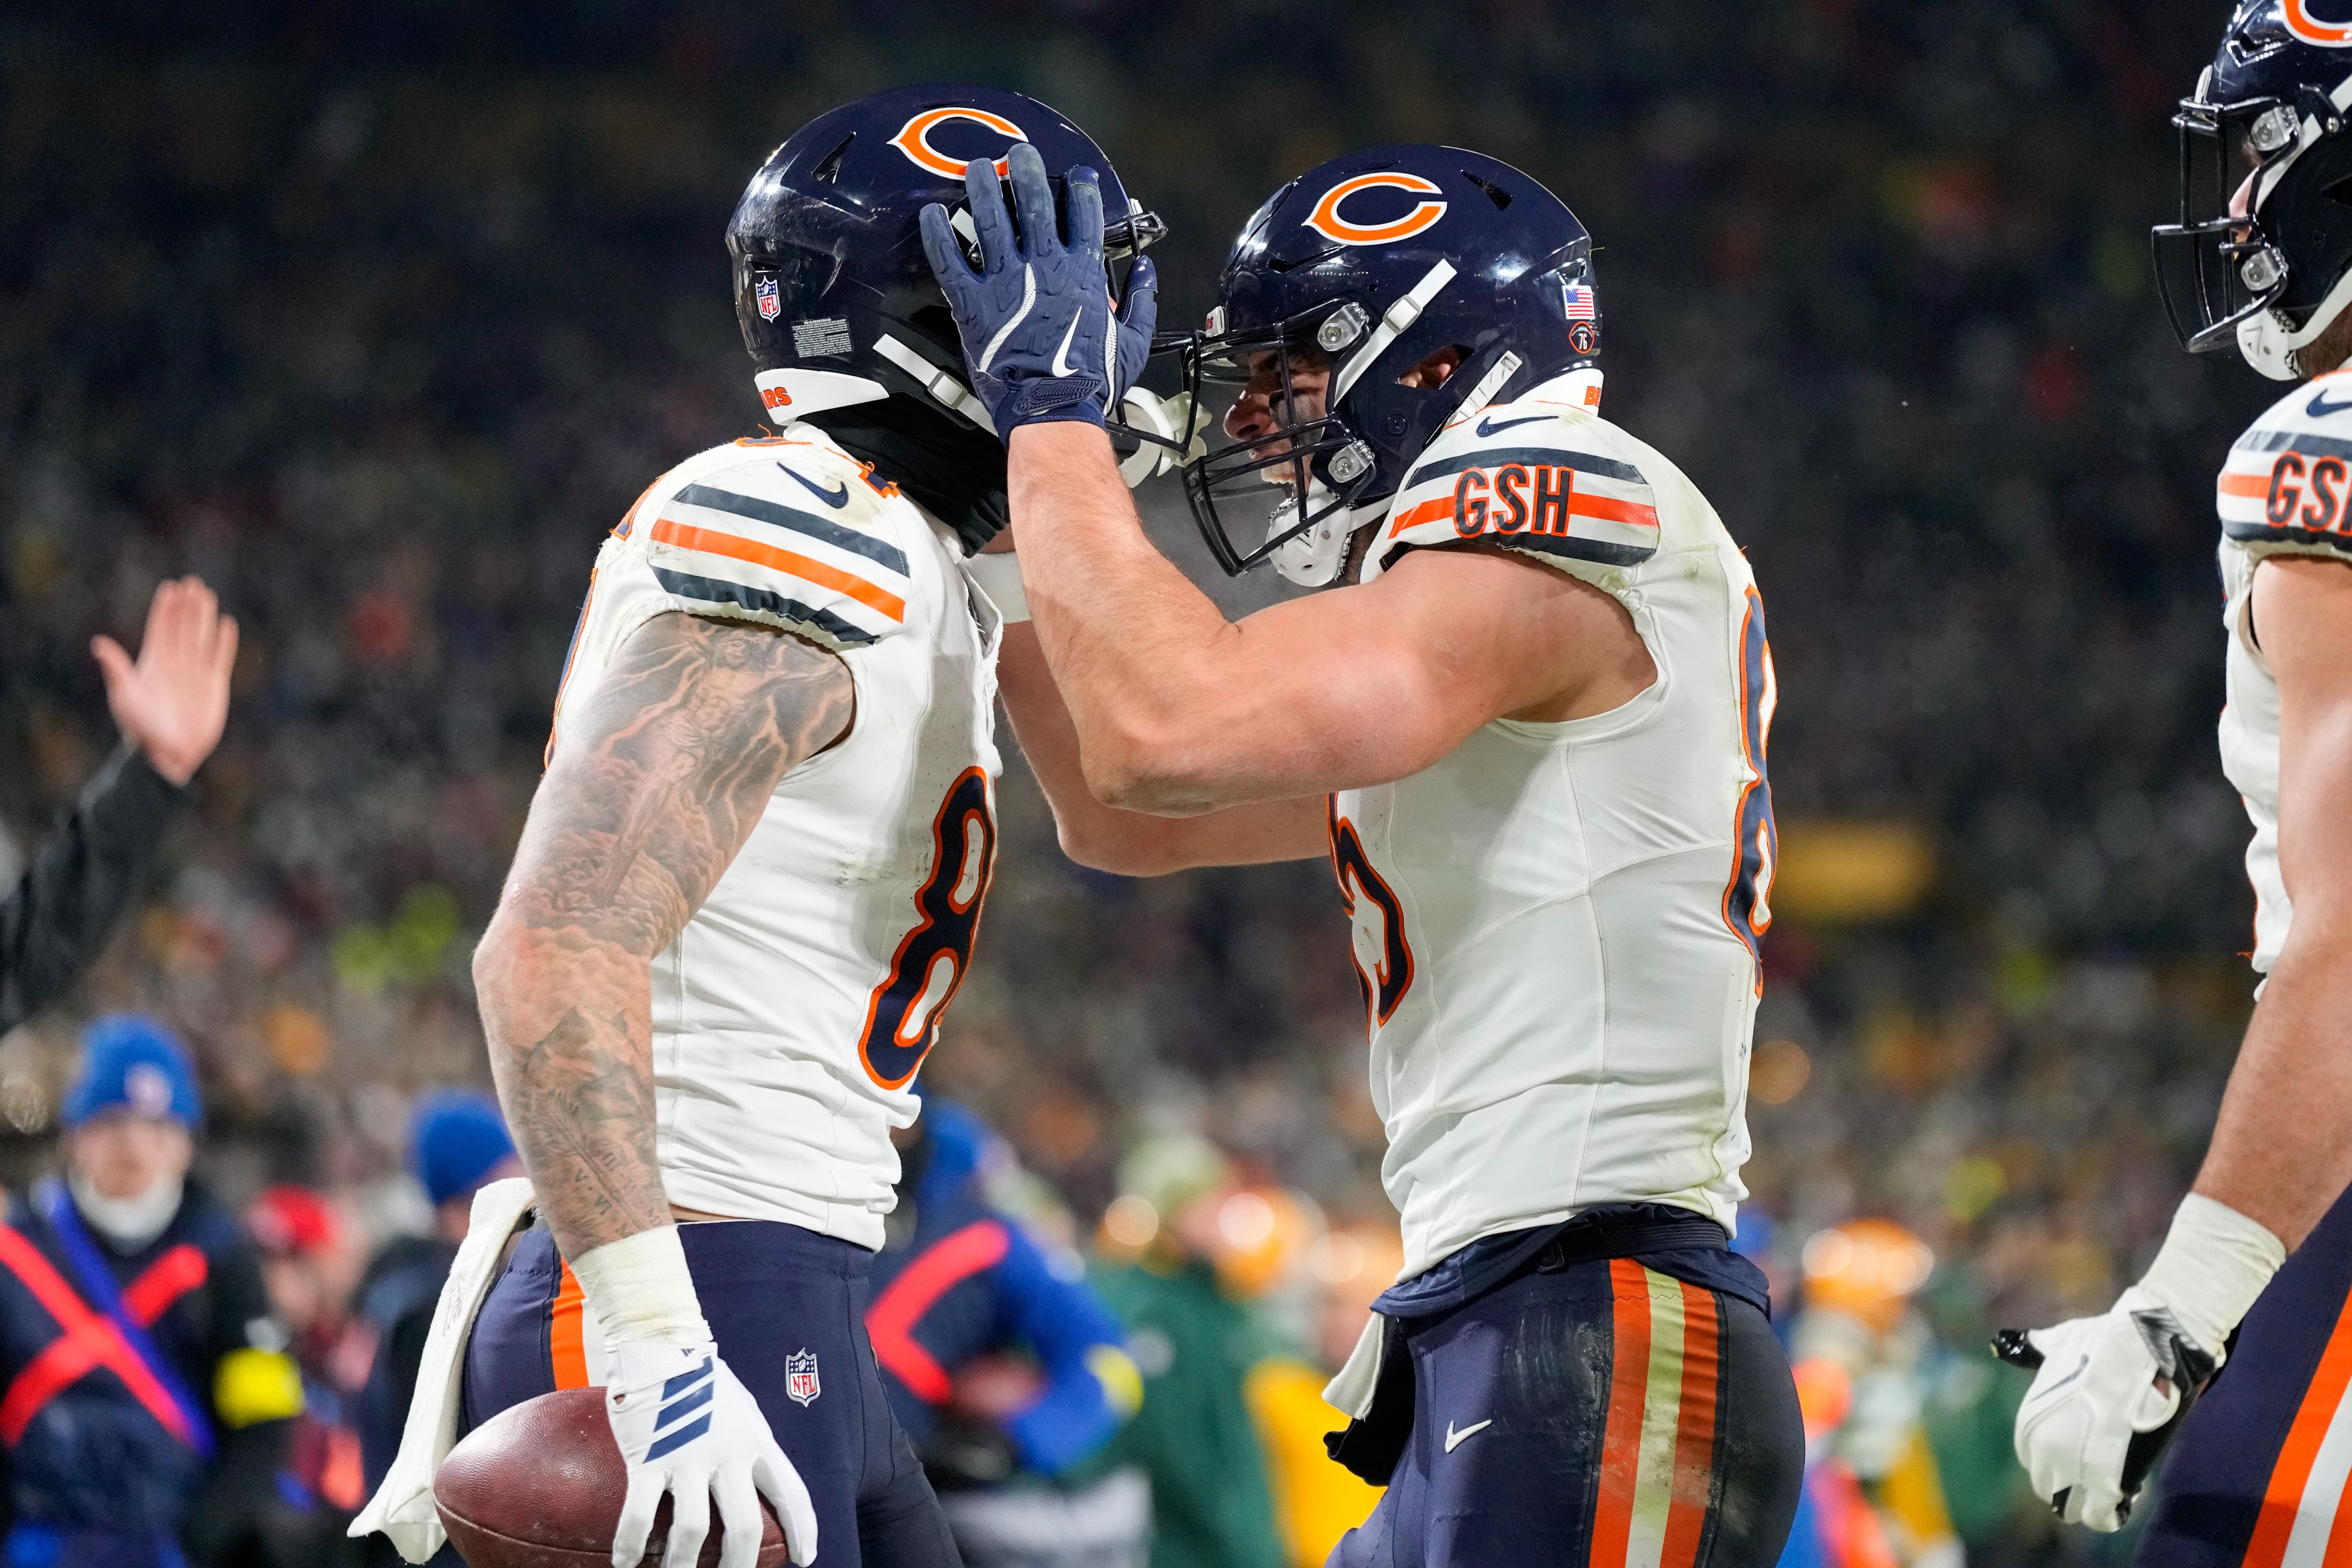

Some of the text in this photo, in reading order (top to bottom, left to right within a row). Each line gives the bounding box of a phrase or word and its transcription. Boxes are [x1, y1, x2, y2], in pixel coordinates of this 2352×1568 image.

[1301, 172, 1447, 246] C
[760, 296, 778, 314] NFL
[1578, 333, 1588, 350] 76
[1453, 463, 1575, 539] GSH
[858, 766, 996, 1090] 8
[792, 1375, 816, 1396] NFL
